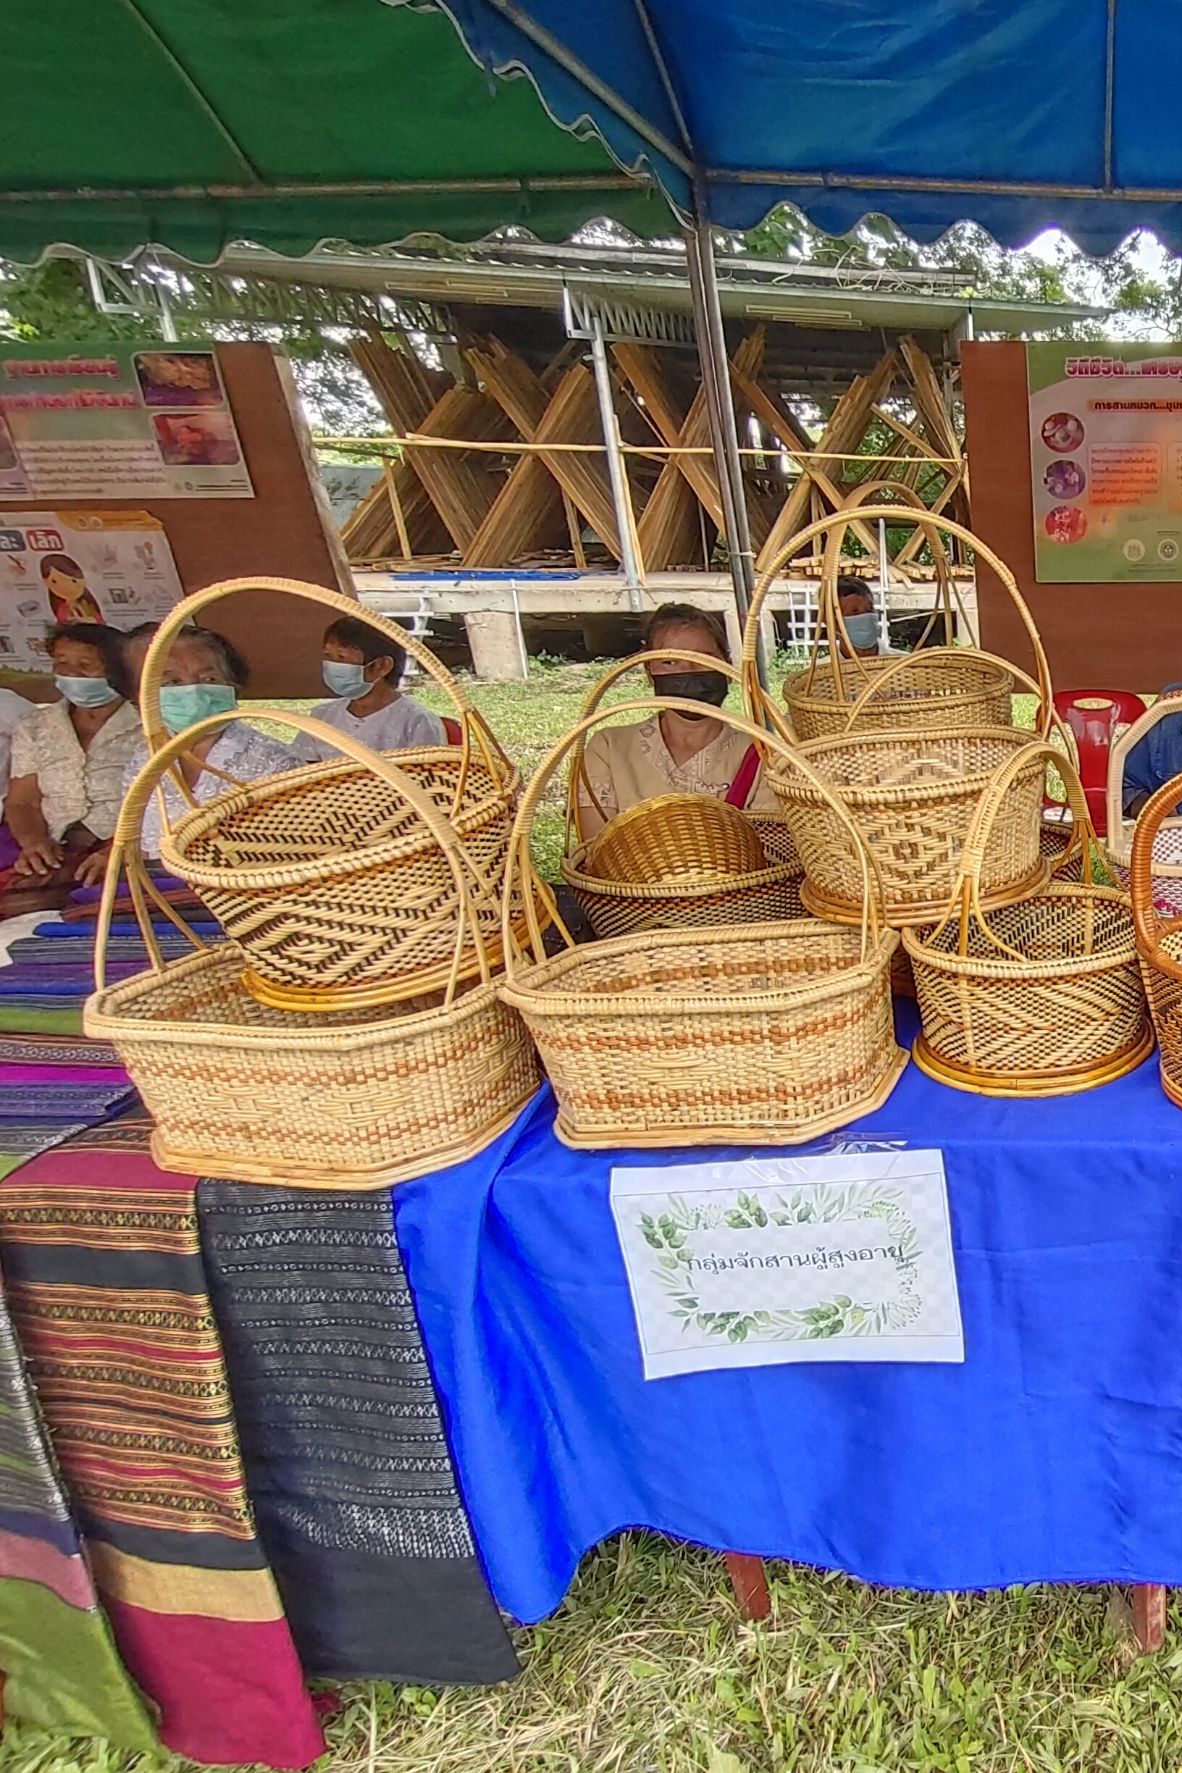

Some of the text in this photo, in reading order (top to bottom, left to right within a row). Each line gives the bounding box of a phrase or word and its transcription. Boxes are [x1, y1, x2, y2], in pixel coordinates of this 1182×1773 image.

[29, 531, 62, 549] เลิก
[687, 1245, 904, 1275] กลุ่มจักสานผู้สูงอายุ
